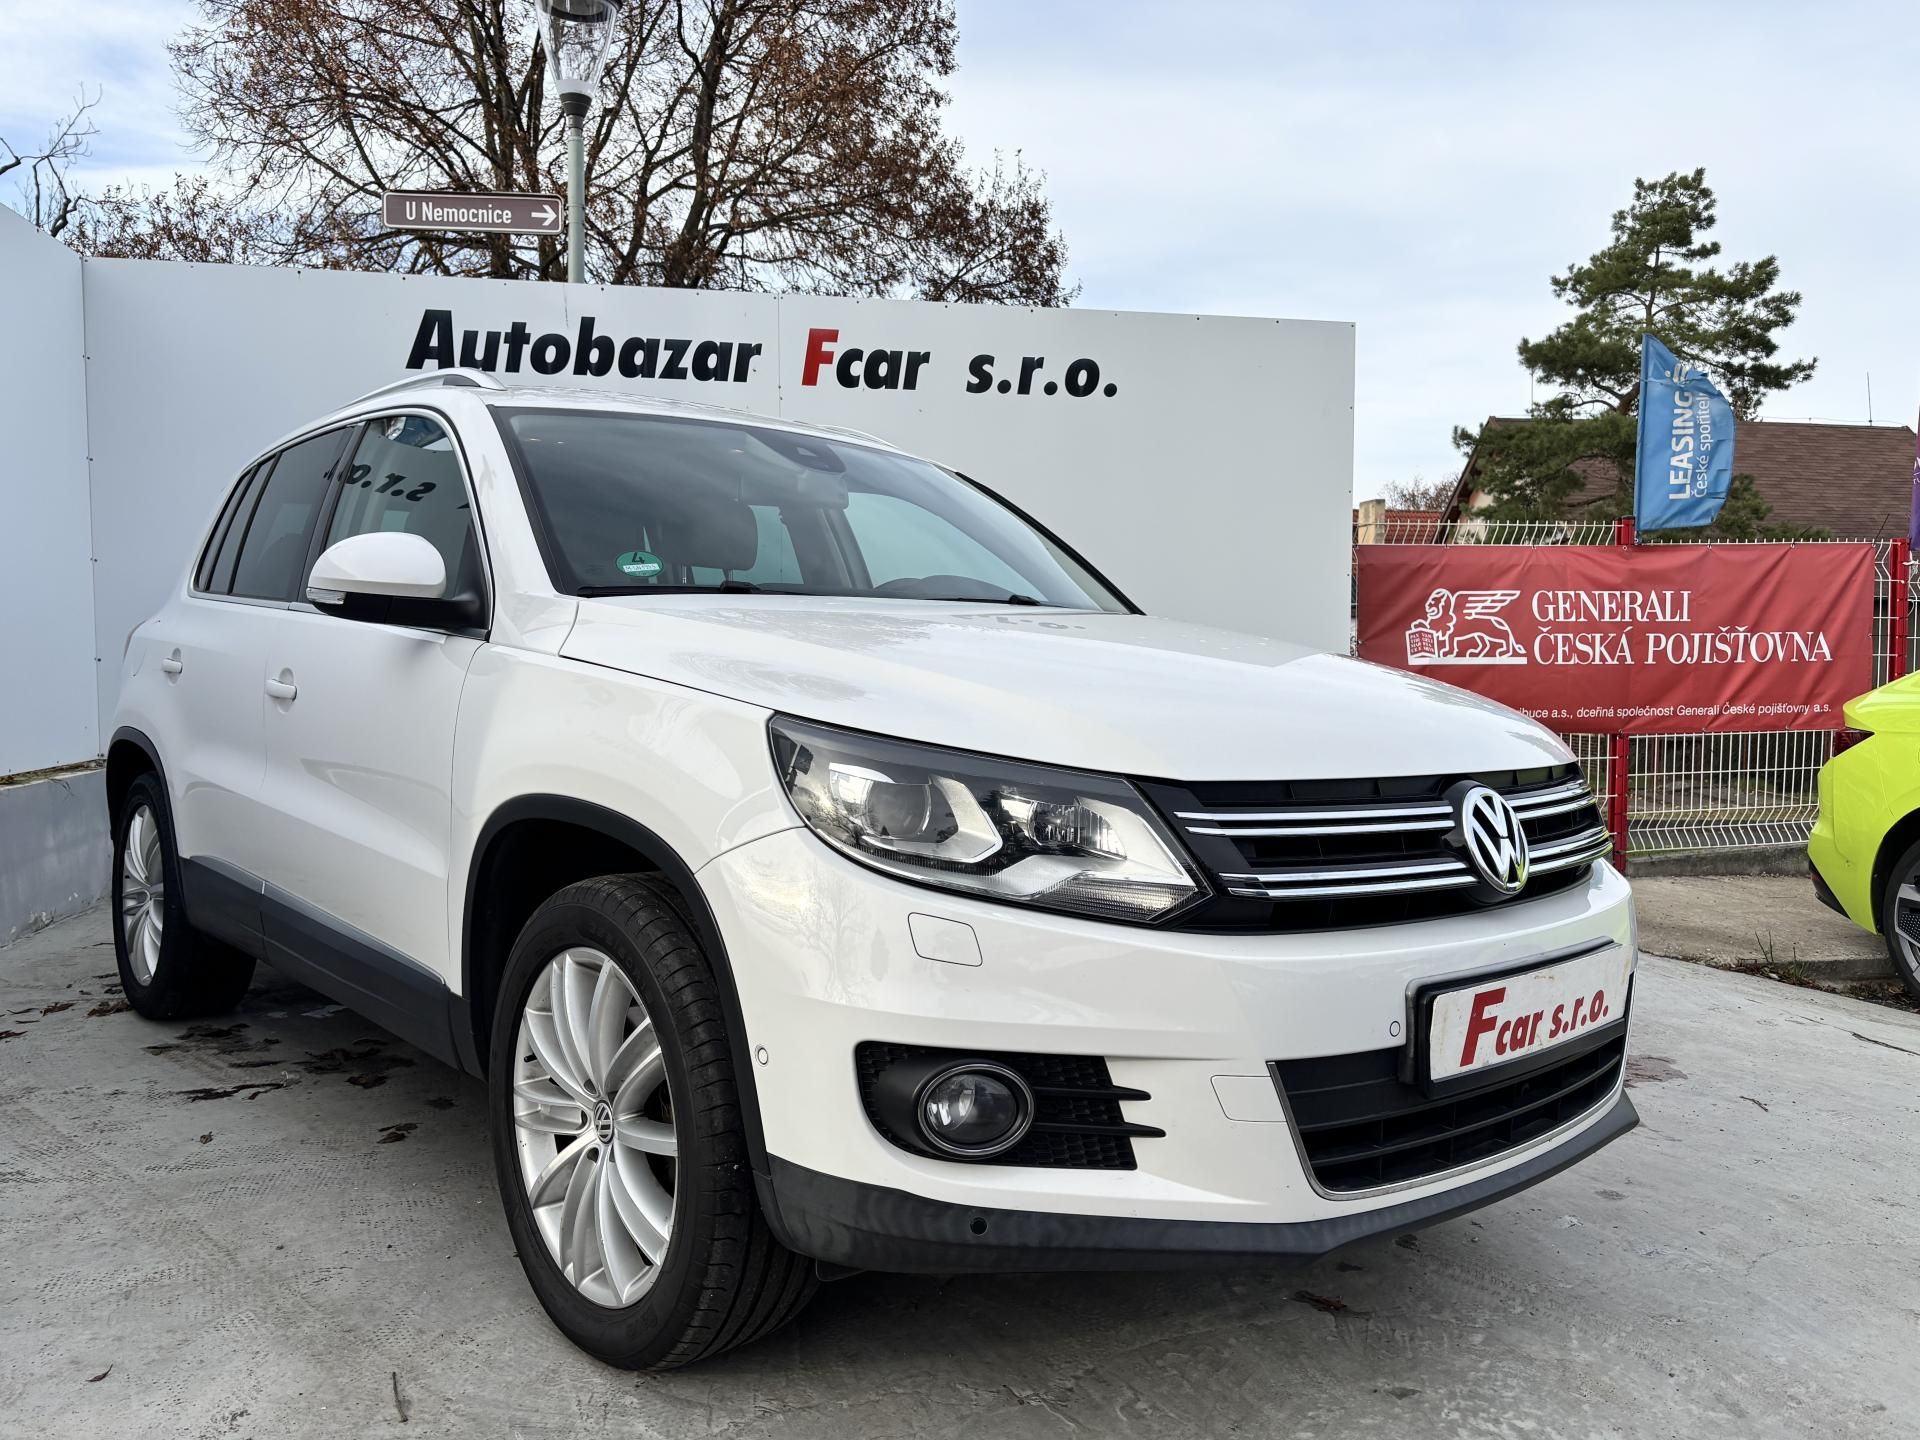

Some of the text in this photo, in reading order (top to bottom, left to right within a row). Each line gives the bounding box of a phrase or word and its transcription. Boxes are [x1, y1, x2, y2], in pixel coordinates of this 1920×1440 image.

[406, 201, 512, 224] U Nemocnice
[406, 309, 1118, 398] Autobazar Fcar s.r.o.
[1669, 390, 1694, 500] LEASING
[1691, 392, 1714, 498] České spořitel
[631, 552, 645, 564] 4
[1532, 589, 1692, 622] GENERALI
[1533, 625, 1833, 665] ČESKÁ POJIŠŤOVNA
[1577, 706, 1614, 718] dceřiná
[1616, 705, 1673, 720] společnost
[1676, 704, 1720, 716] Generali
[1722, 701, 1755, 715] České
[1758, 702, 1810, 717] pojišťovny
[1813, 703, 1832, 713] a.s.
[1460, 986, 1609, 1067] Fcar s.r.o.
